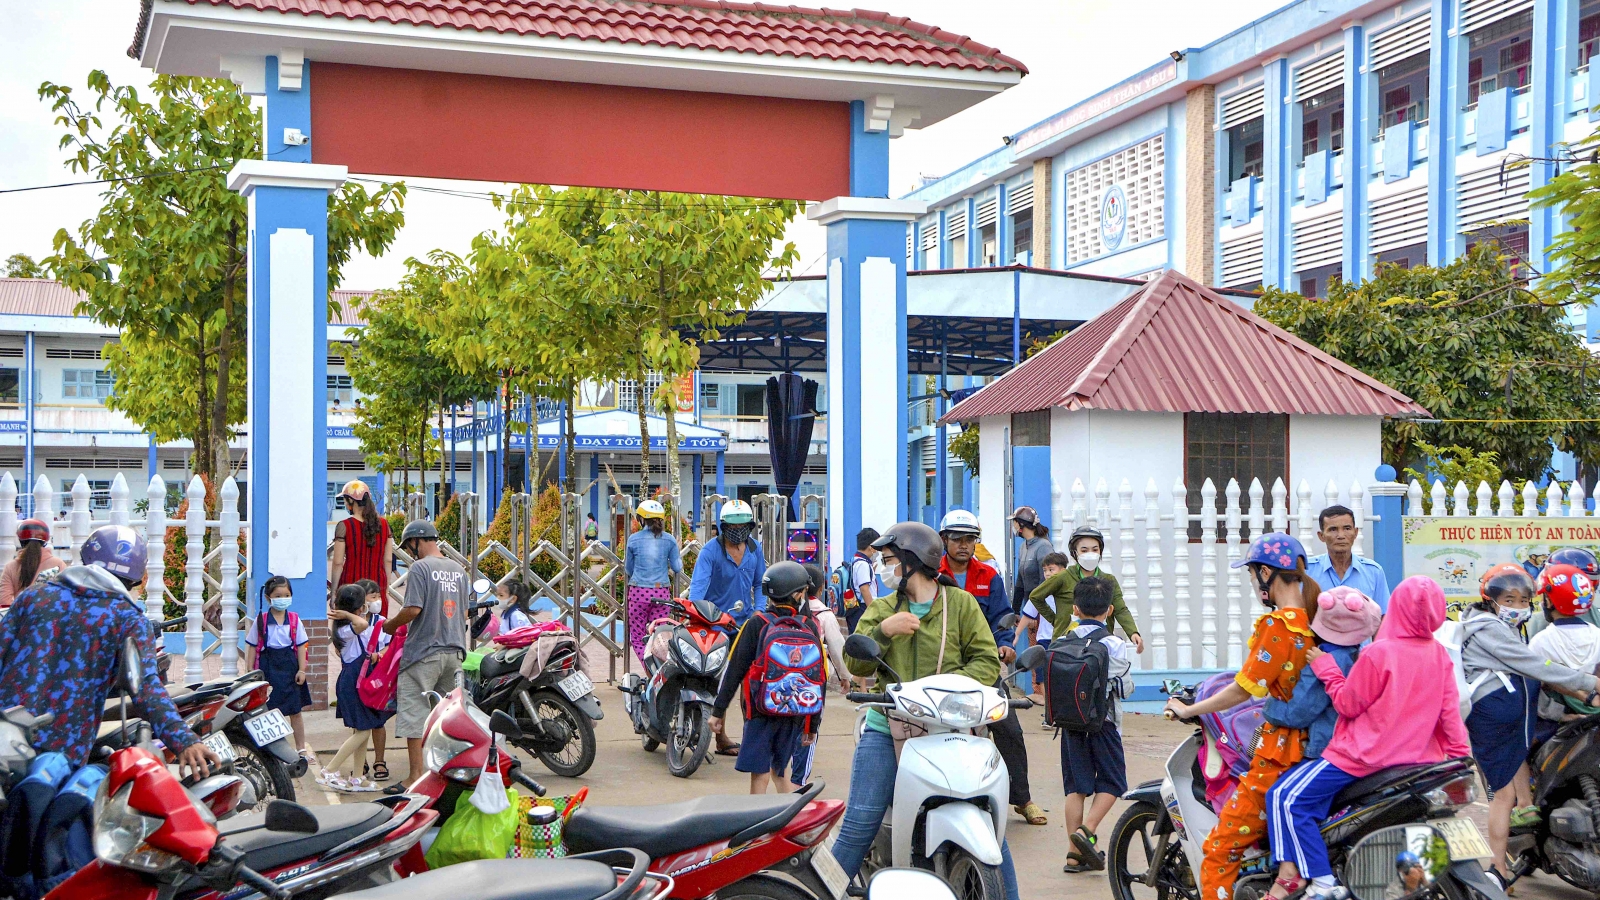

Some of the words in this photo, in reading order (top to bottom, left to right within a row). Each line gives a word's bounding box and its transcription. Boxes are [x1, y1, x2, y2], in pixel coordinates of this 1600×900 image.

[1088, 99, 1111, 116] SINH
[1114, 83, 1142, 104] THÂN
[1144, 69, 1167, 88] YÊU
[582, 438, 612, 446] DẠY
[615, 437, 642, 446] TỐT
[657, 439, 686, 447] HC
[690, 437, 718, 447] TỐT
[1439, 525, 1475, 543] THỰC
[1480, 524, 1512, 543] HIỆN
[1516, 522, 1542, 540] TỐT
[1546, 527, 1563, 540] AN
[1568, 524, 1600, 540] TOÀN
[432, 570, 464, 583] OCCUPY
[251, 713, 280, 731] 67-L1
[256, 722, 290, 743] 460.21
[1451, 839, 1490, 856] 33.01
